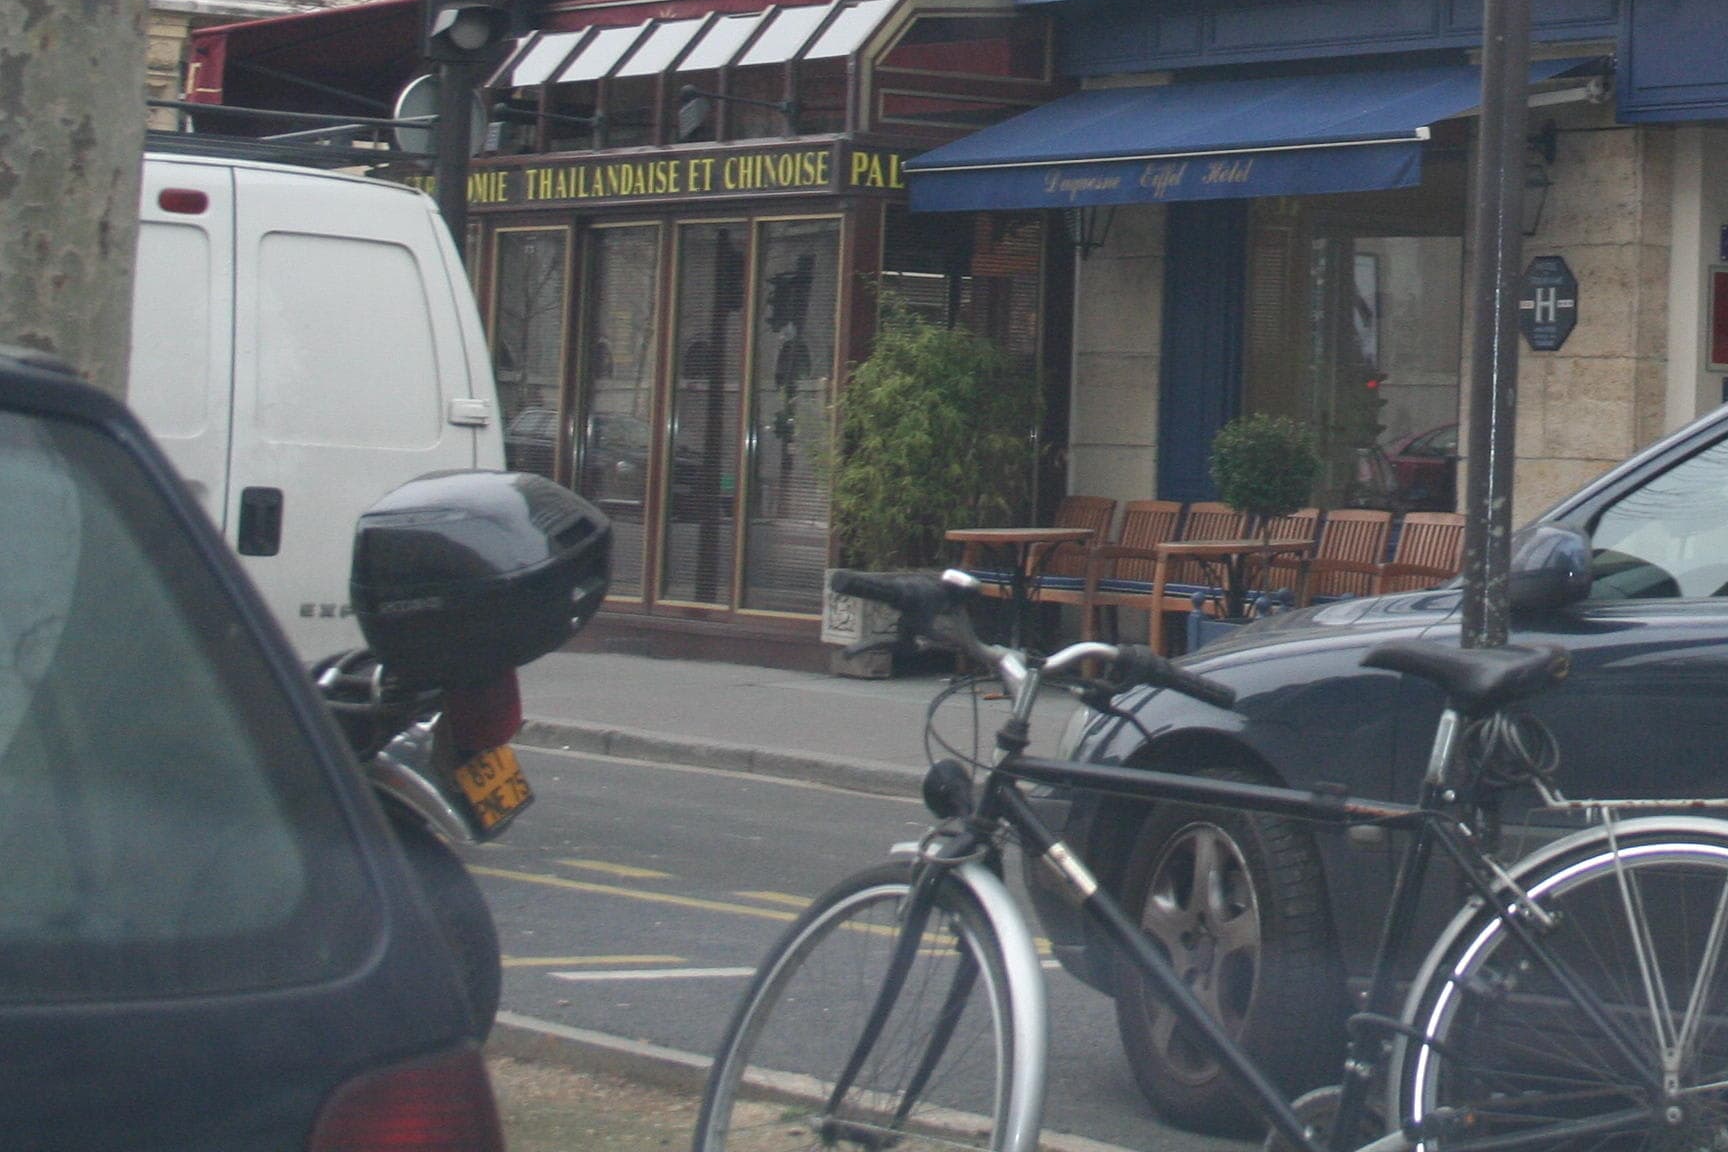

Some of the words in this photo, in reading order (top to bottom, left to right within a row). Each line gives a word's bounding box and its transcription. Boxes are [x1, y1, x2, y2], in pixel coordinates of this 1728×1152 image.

[525, 159, 682, 202] THAILANDAISE
[688, 157, 716, 193] ET
[723, 150, 830, 190] CHINOISE
[849, 151, 905, 189] PAL
